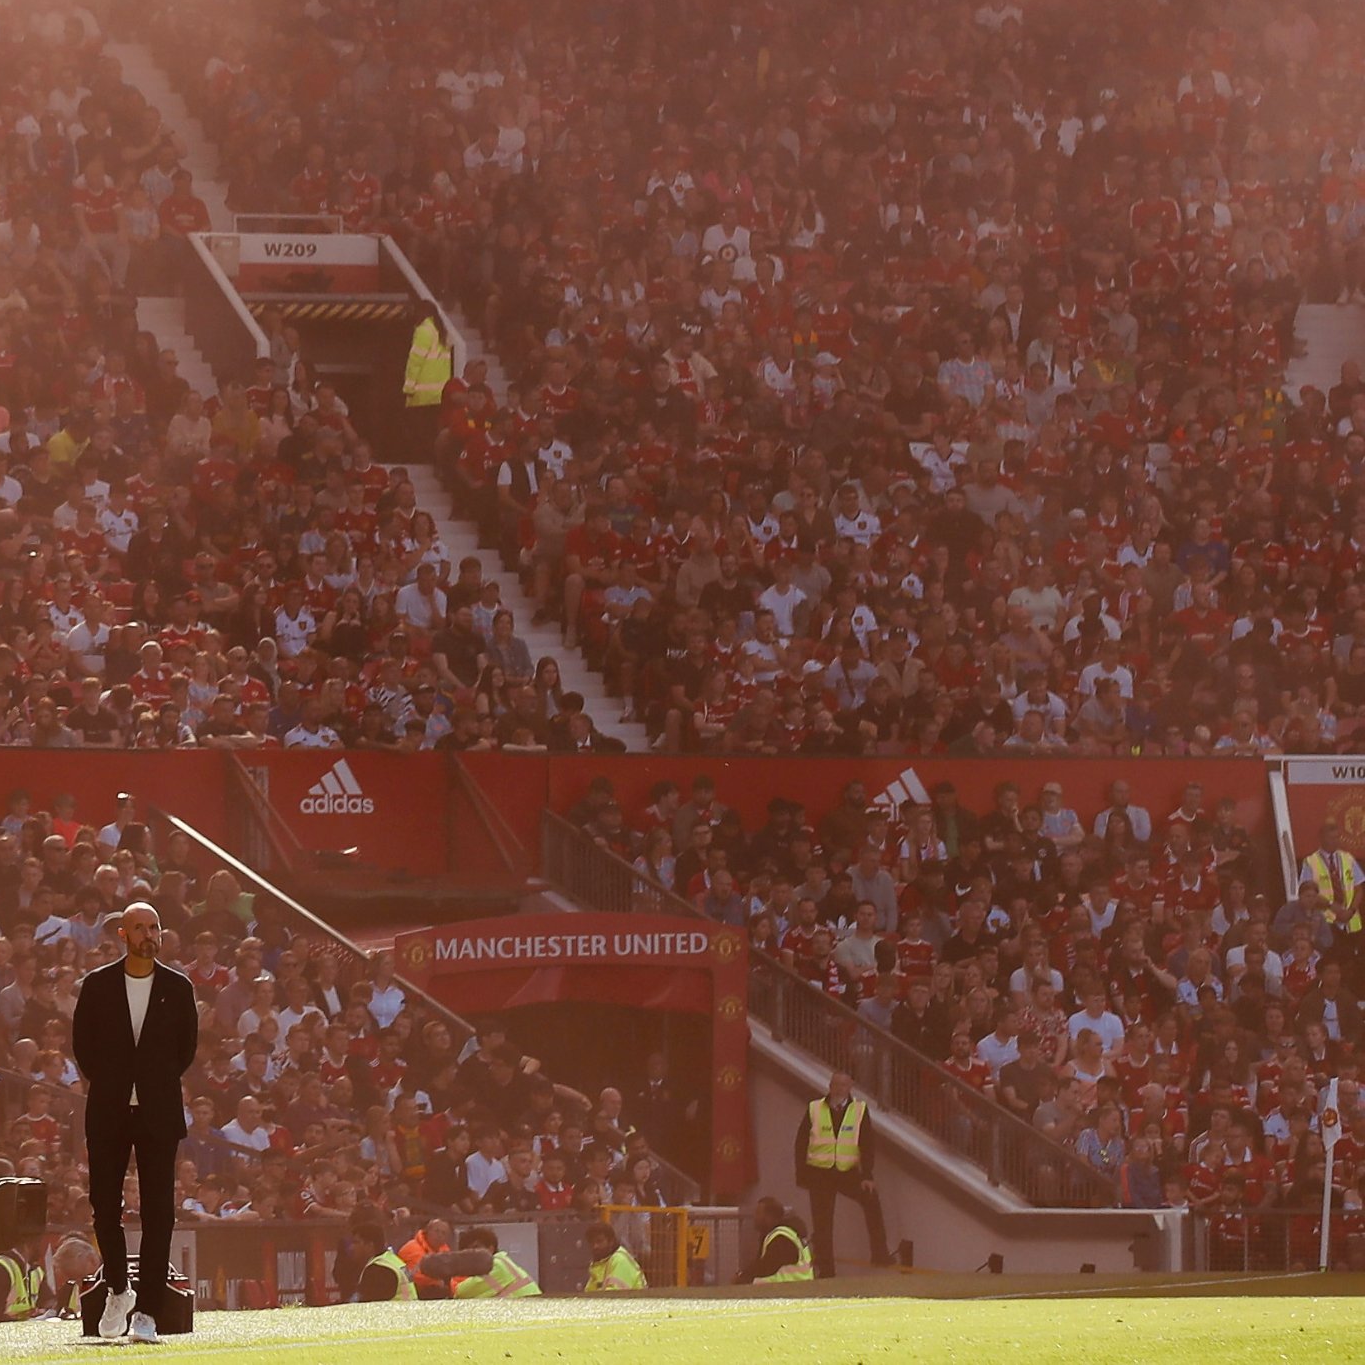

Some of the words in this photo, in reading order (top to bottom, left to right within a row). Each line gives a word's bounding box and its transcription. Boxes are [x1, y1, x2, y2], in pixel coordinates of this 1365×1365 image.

[265, 243, 317, 257] W209
[300, 794, 374, 814] adidas
[435, 934, 607, 960] MANCHESTER
[613, 932, 708, 956] UNITED
